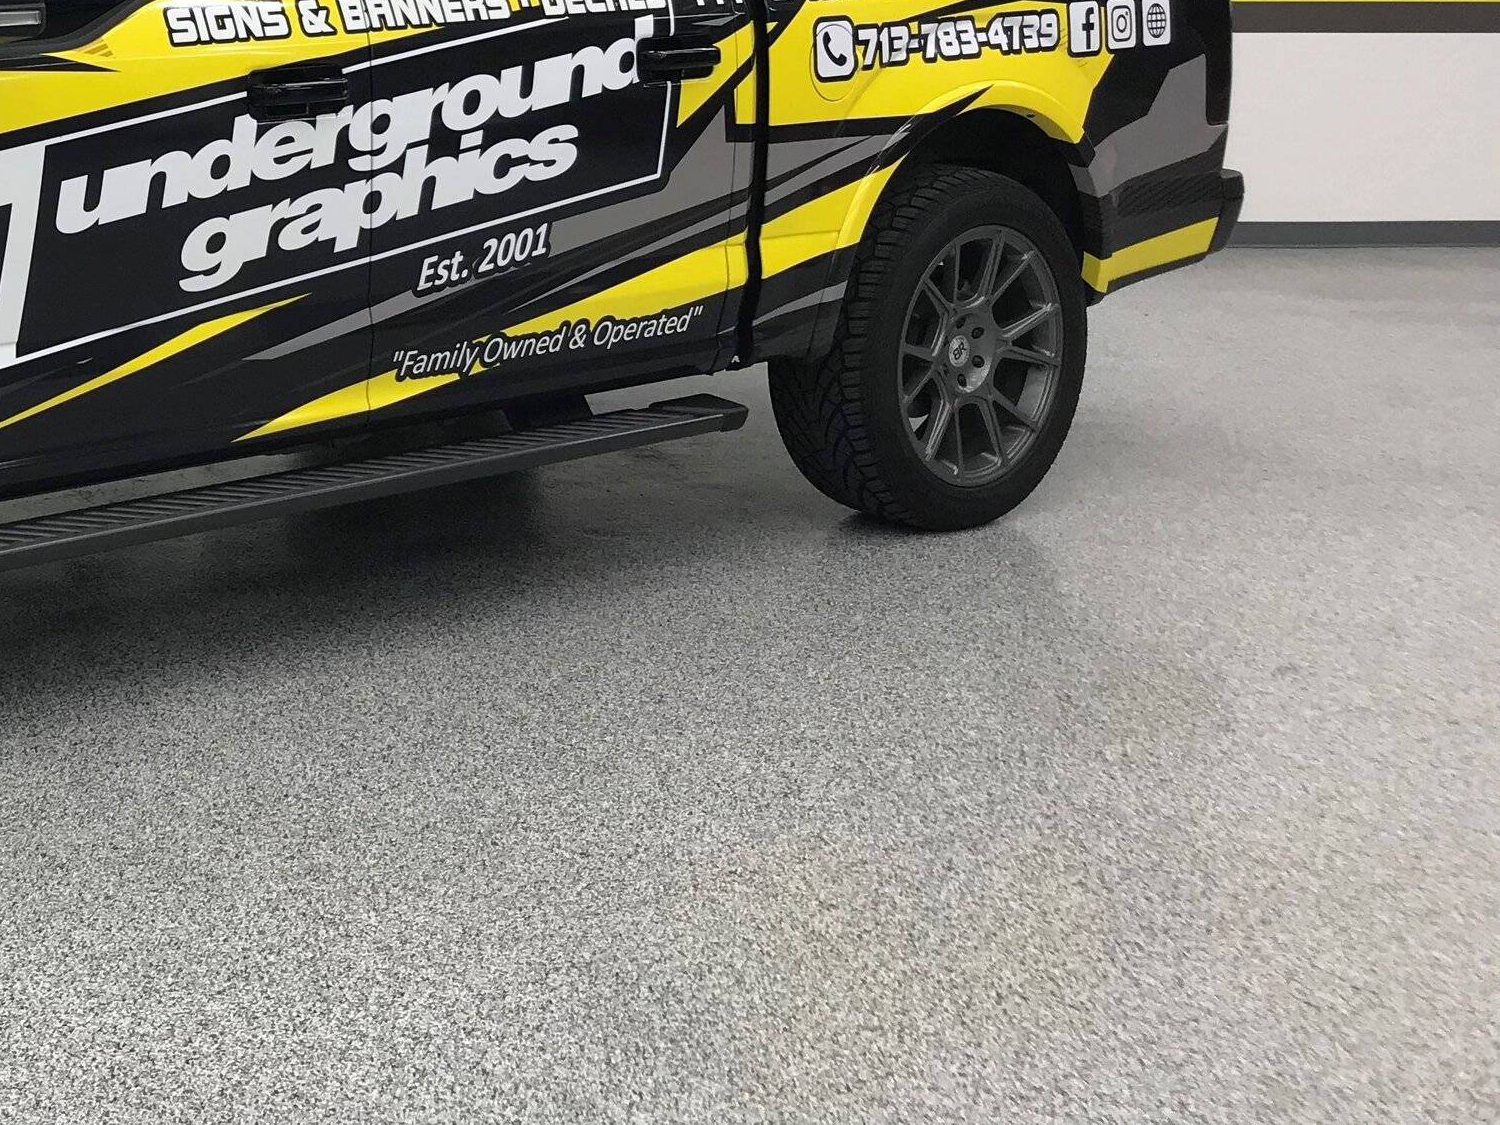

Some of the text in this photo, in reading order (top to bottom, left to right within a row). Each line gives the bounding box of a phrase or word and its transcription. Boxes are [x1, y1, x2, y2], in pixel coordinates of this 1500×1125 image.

[167, 0, 289, 44] SIGNS
[858, 14, 1059, 66] 713-783-4739
[56, 15, 654, 235] underground
[179, 124, 577, 292] graphics
[416, 222, 549, 292] Est. 2001
[483, 325, 570, 364] Owned
[570, 326, 588, 351] &
